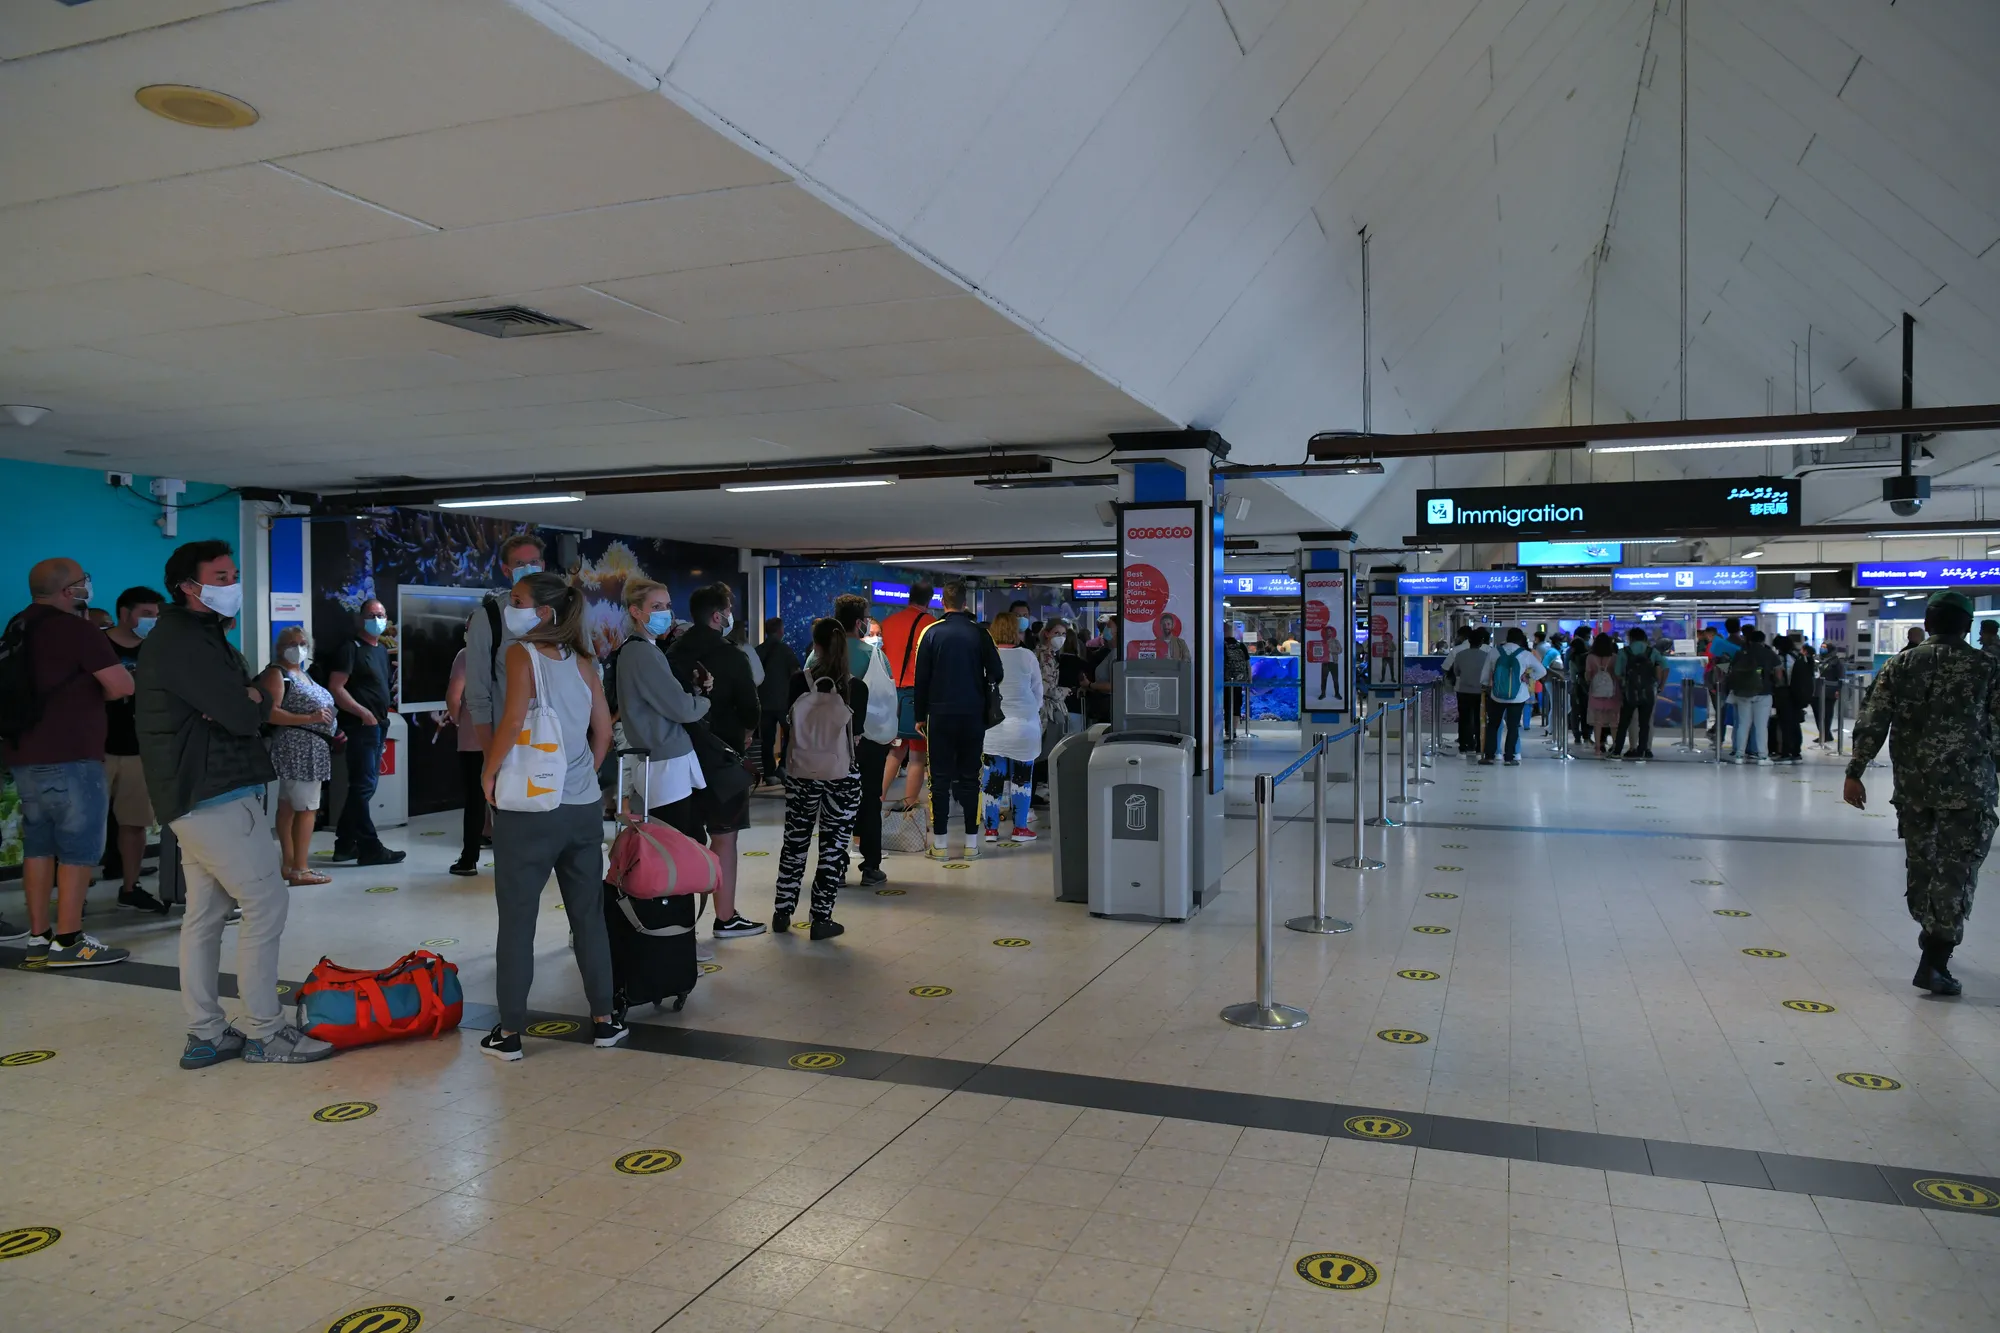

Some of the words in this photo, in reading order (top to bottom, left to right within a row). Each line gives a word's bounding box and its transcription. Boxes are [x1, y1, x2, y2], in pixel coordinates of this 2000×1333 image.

[1750, 502, 1788, 515] 移民局
[1457, 504, 1583, 527] Immigration
[1129, 527, 1191, 538] ooredoo
[1862, 570, 1907, 578] Maldivians
[1908, 570, 1927, 579] only
[1300, 1257, 1313, 1272] PLEASE
[1335, 1255, 1362, 1264] SOCIAL
[1307, 1277, 1331, 1287] STAND
[336, 1311, 369, 1327] PLEASE
